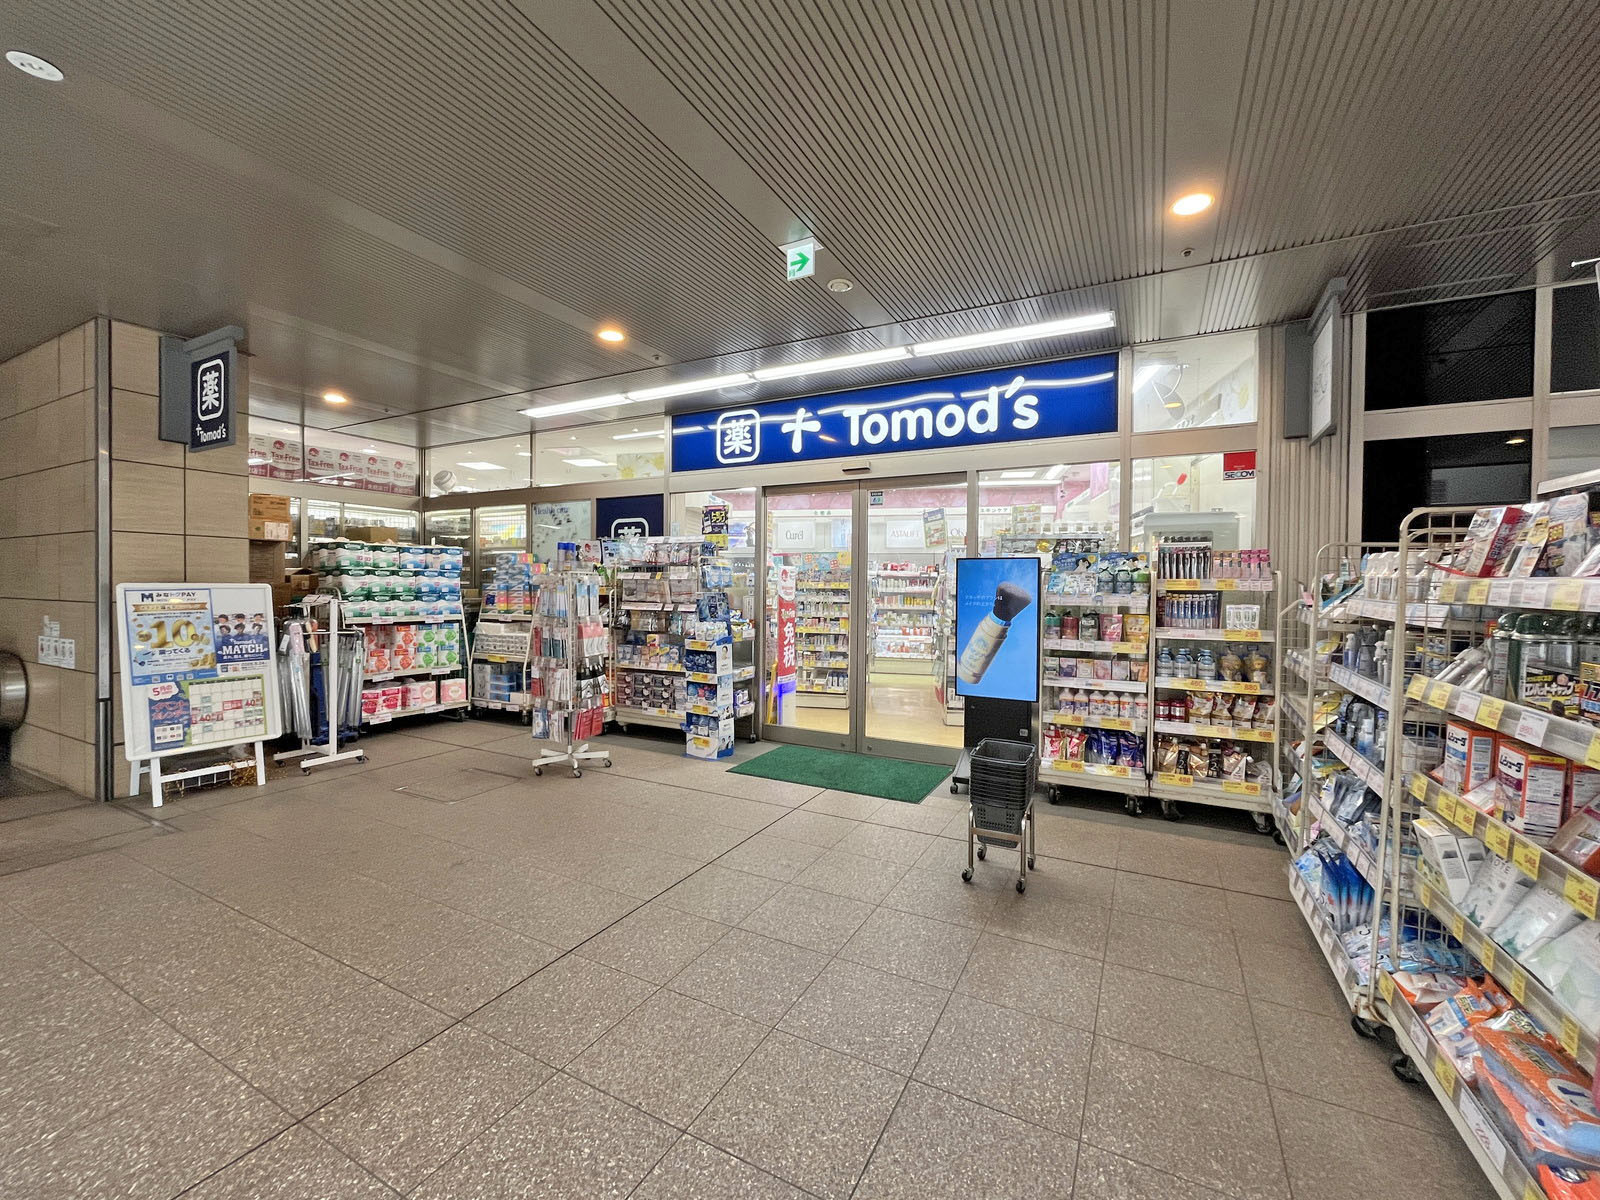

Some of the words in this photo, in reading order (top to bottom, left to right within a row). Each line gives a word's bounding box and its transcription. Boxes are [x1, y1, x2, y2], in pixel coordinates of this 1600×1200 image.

[202, 371, 219, 410] 薬
[843, 376, 1039, 446] Tomod's
[200, 423, 226, 442] Tomod's
[724, 419, 752, 454] 薬
[1225, 470, 1254, 478] SECOM
[222, 643, 264, 655] MATCH
[783, 622, 795, 668] 免税
